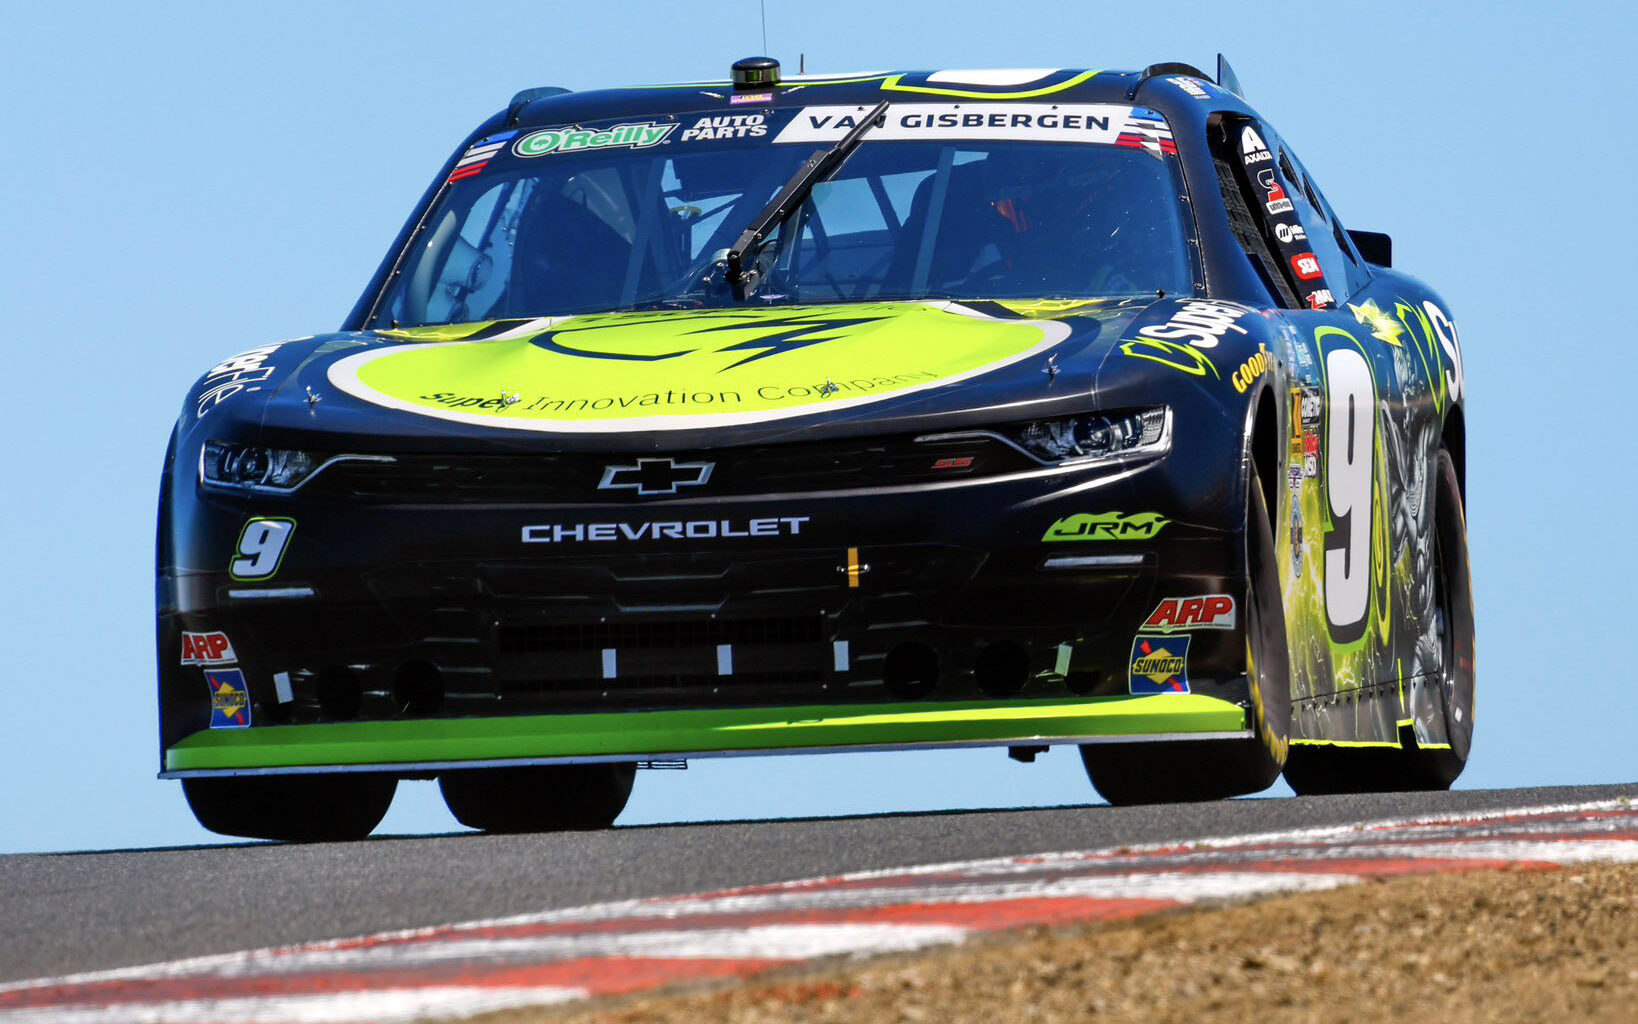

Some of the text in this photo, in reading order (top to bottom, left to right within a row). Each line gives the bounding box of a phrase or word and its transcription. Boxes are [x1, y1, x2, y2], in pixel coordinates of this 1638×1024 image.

[693, 114, 764, 129] AUTO
[900, 114, 1110, 131] GISBERGEN
[519, 125, 672, 156] O'Reilly
[681, 125, 768, 142] PARTS
[1244, 150, 1273, 165] AXALTA
[523, 387, 741, 411] Innovation
[757, 369, 939, 401] Company
[1325, 349, 1375, 627] 9
[521, 516, 810, 544] CHEVROLET
[1053, 520, 1155, 540] JRM
[232, 520, 294, 577] 9
[1144, 596, 1233, 625] ARP
[182, 635, 230, 660] ARP
[1134, 657, 1183, 675] SUNOCO
[214, 691, 247, 708] SUNOCO
